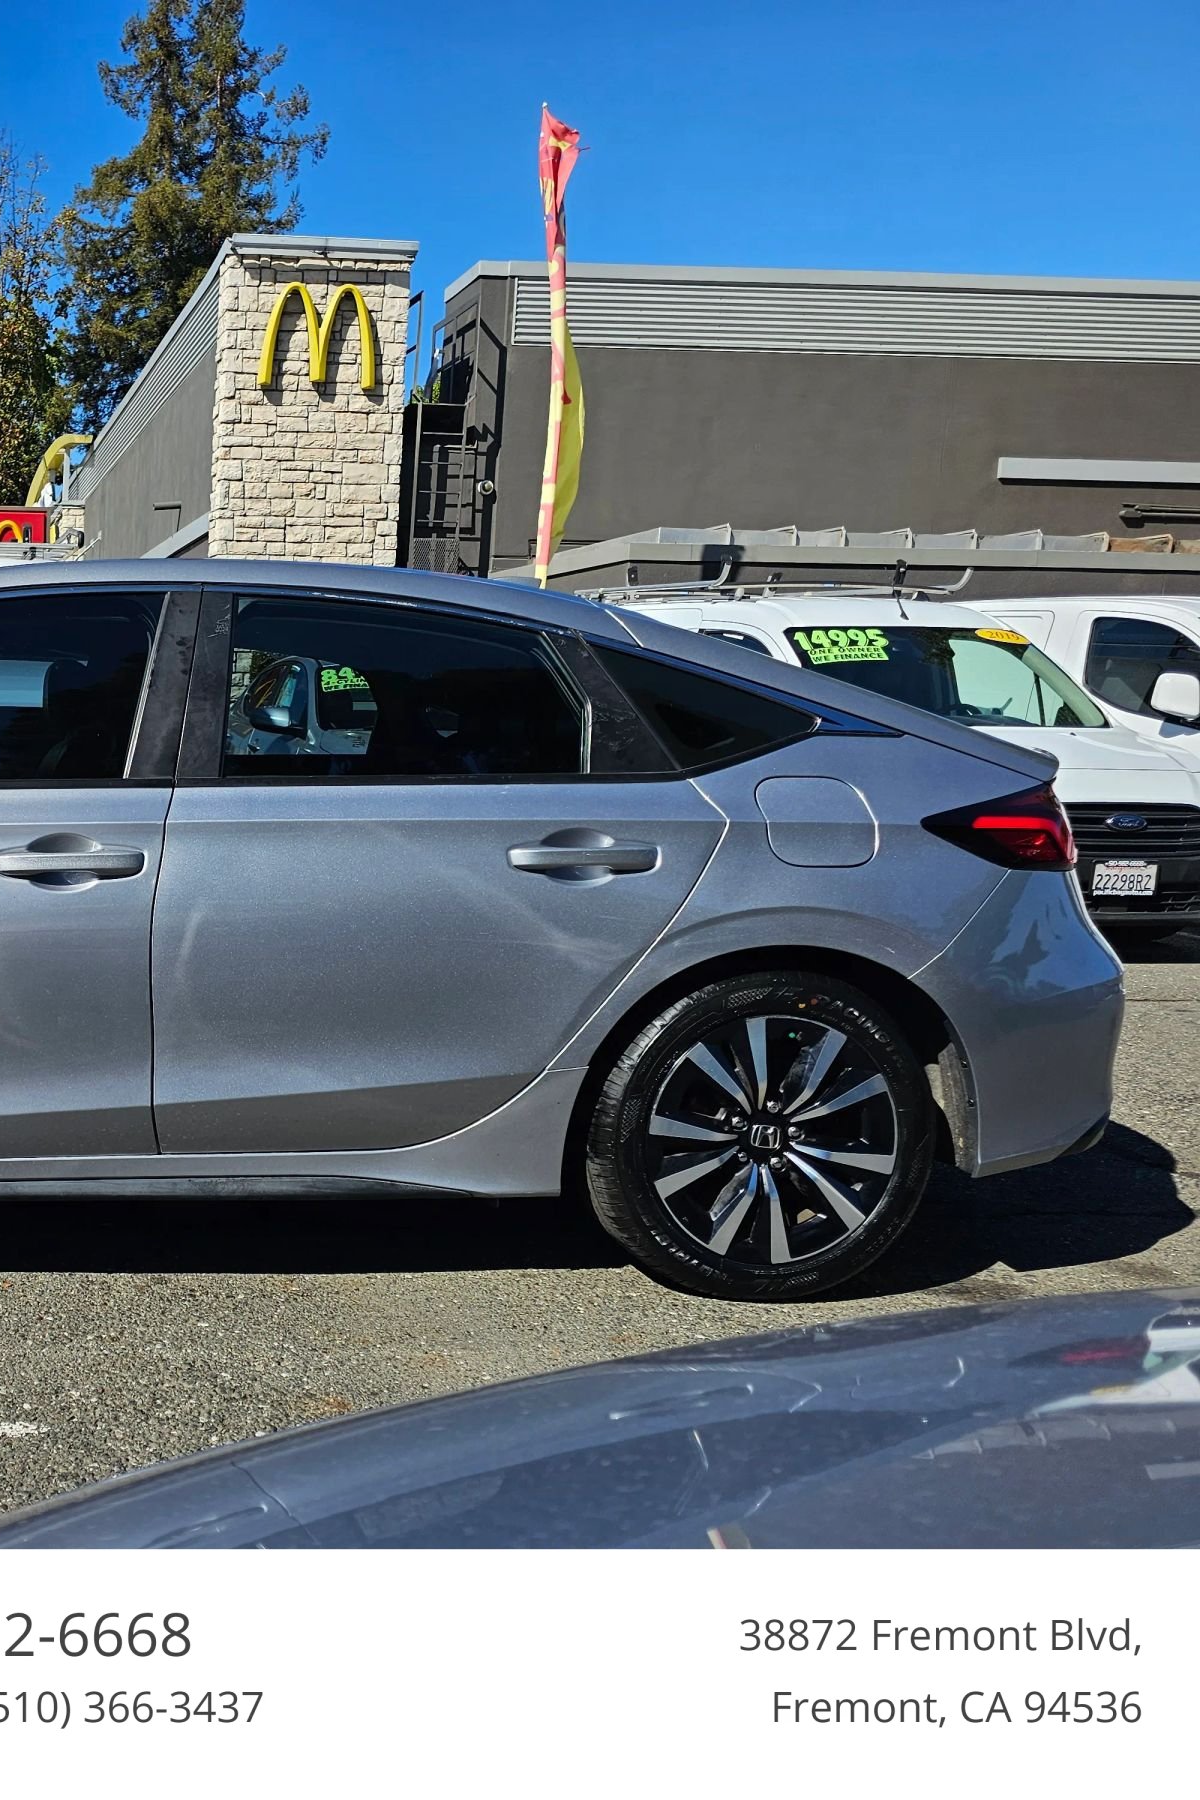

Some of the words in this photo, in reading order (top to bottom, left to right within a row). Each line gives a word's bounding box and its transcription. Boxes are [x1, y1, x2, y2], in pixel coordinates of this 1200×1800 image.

[793, 628, 889, 651] 14995
[809, 647, 834, 656] ONE
[837, 646, 882, 655] OWNER
[812, 654, 831, 663] WE
[833, 651, 885, 661] FINANCE
[320, 666, 358, 683] 84
